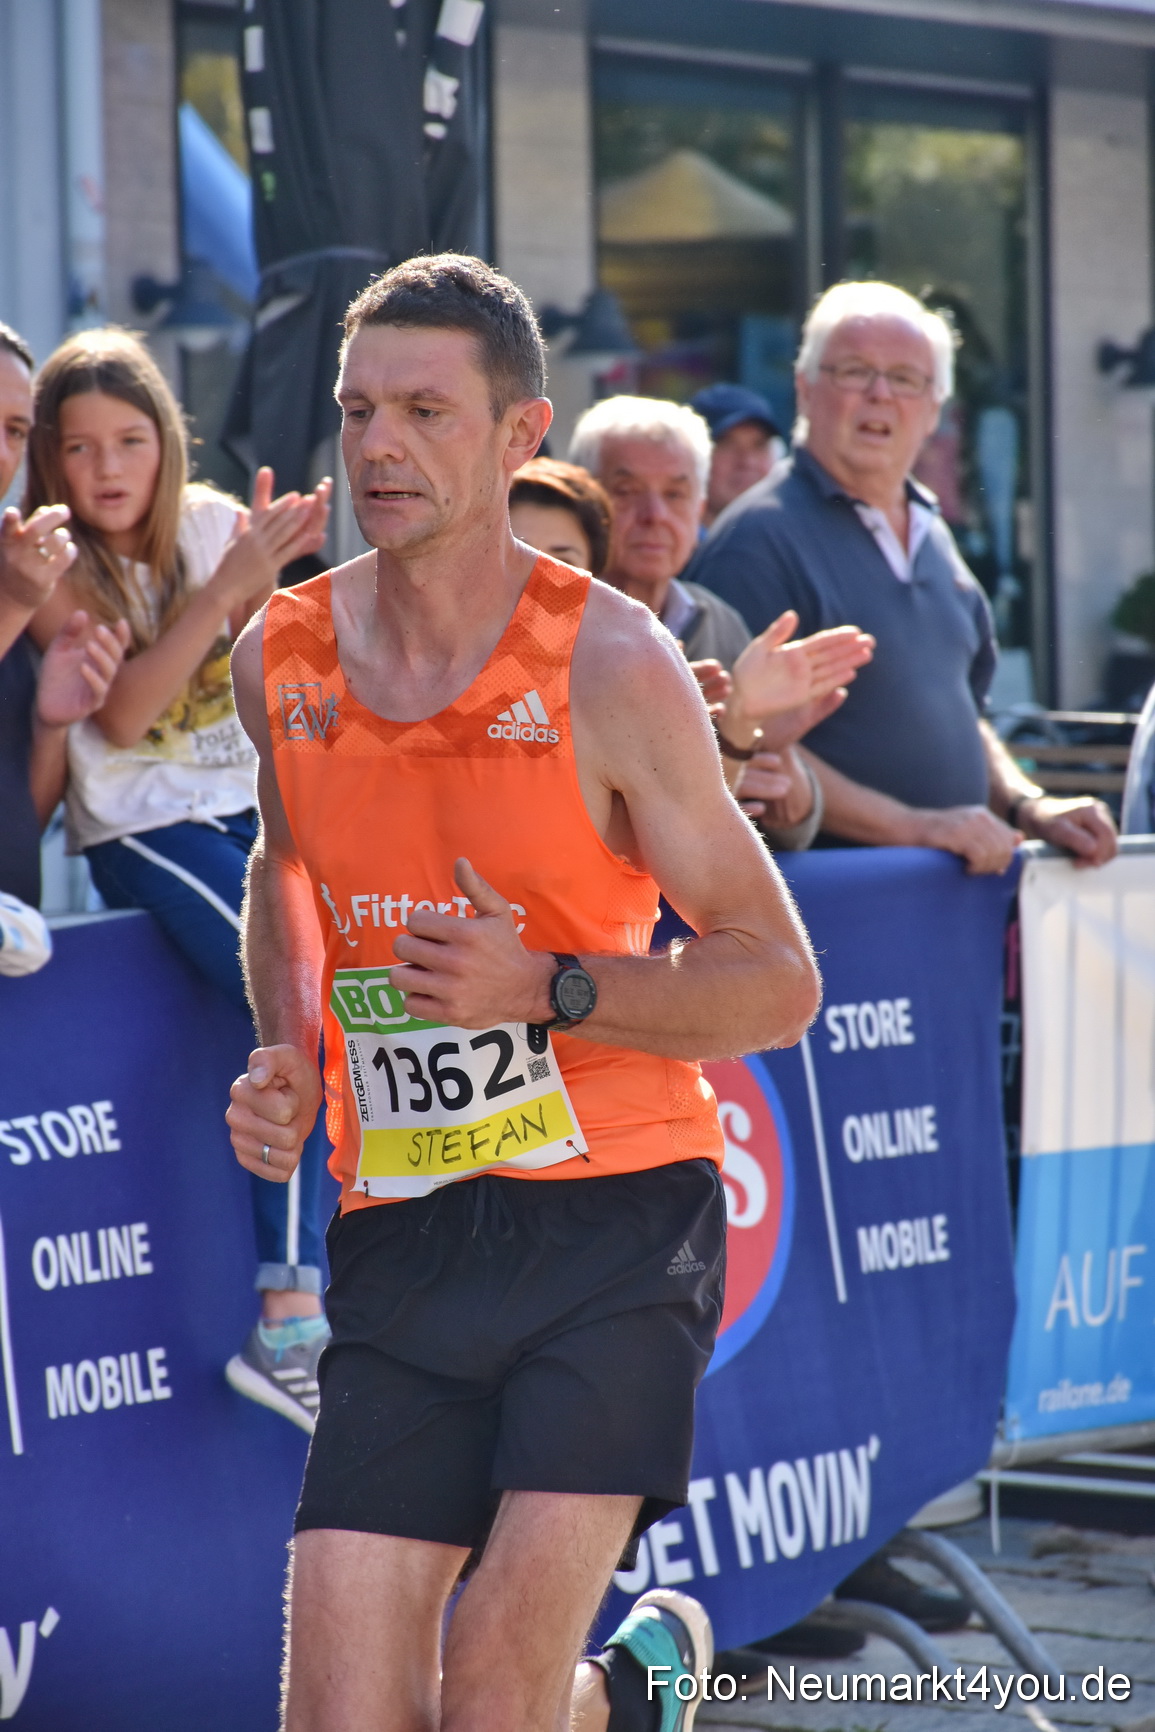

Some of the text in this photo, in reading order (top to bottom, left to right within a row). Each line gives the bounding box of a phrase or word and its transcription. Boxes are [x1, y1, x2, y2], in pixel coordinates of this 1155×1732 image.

[487, 721, 560, 744] adidas
[825, 997, 915, 1053] STORE
[372, 1029, 526, 1113] 1362
[0, 1100, 121, 1166] STORE
[407, 1102, 548, 1168] STEFAN
[842, 1105, 939, 1163] ONLINE
[32, 1222, 153, 1291] ONLINE
[666, 1260, 706, 1276] adidas
[857, 1213, 951, 1274] MOBILE
[1044, 1244, 1147, 1333] AUF
[45, 1347, 172, 1419] MOBILE
[724, 1433, 881, 1569] MOVIN'
